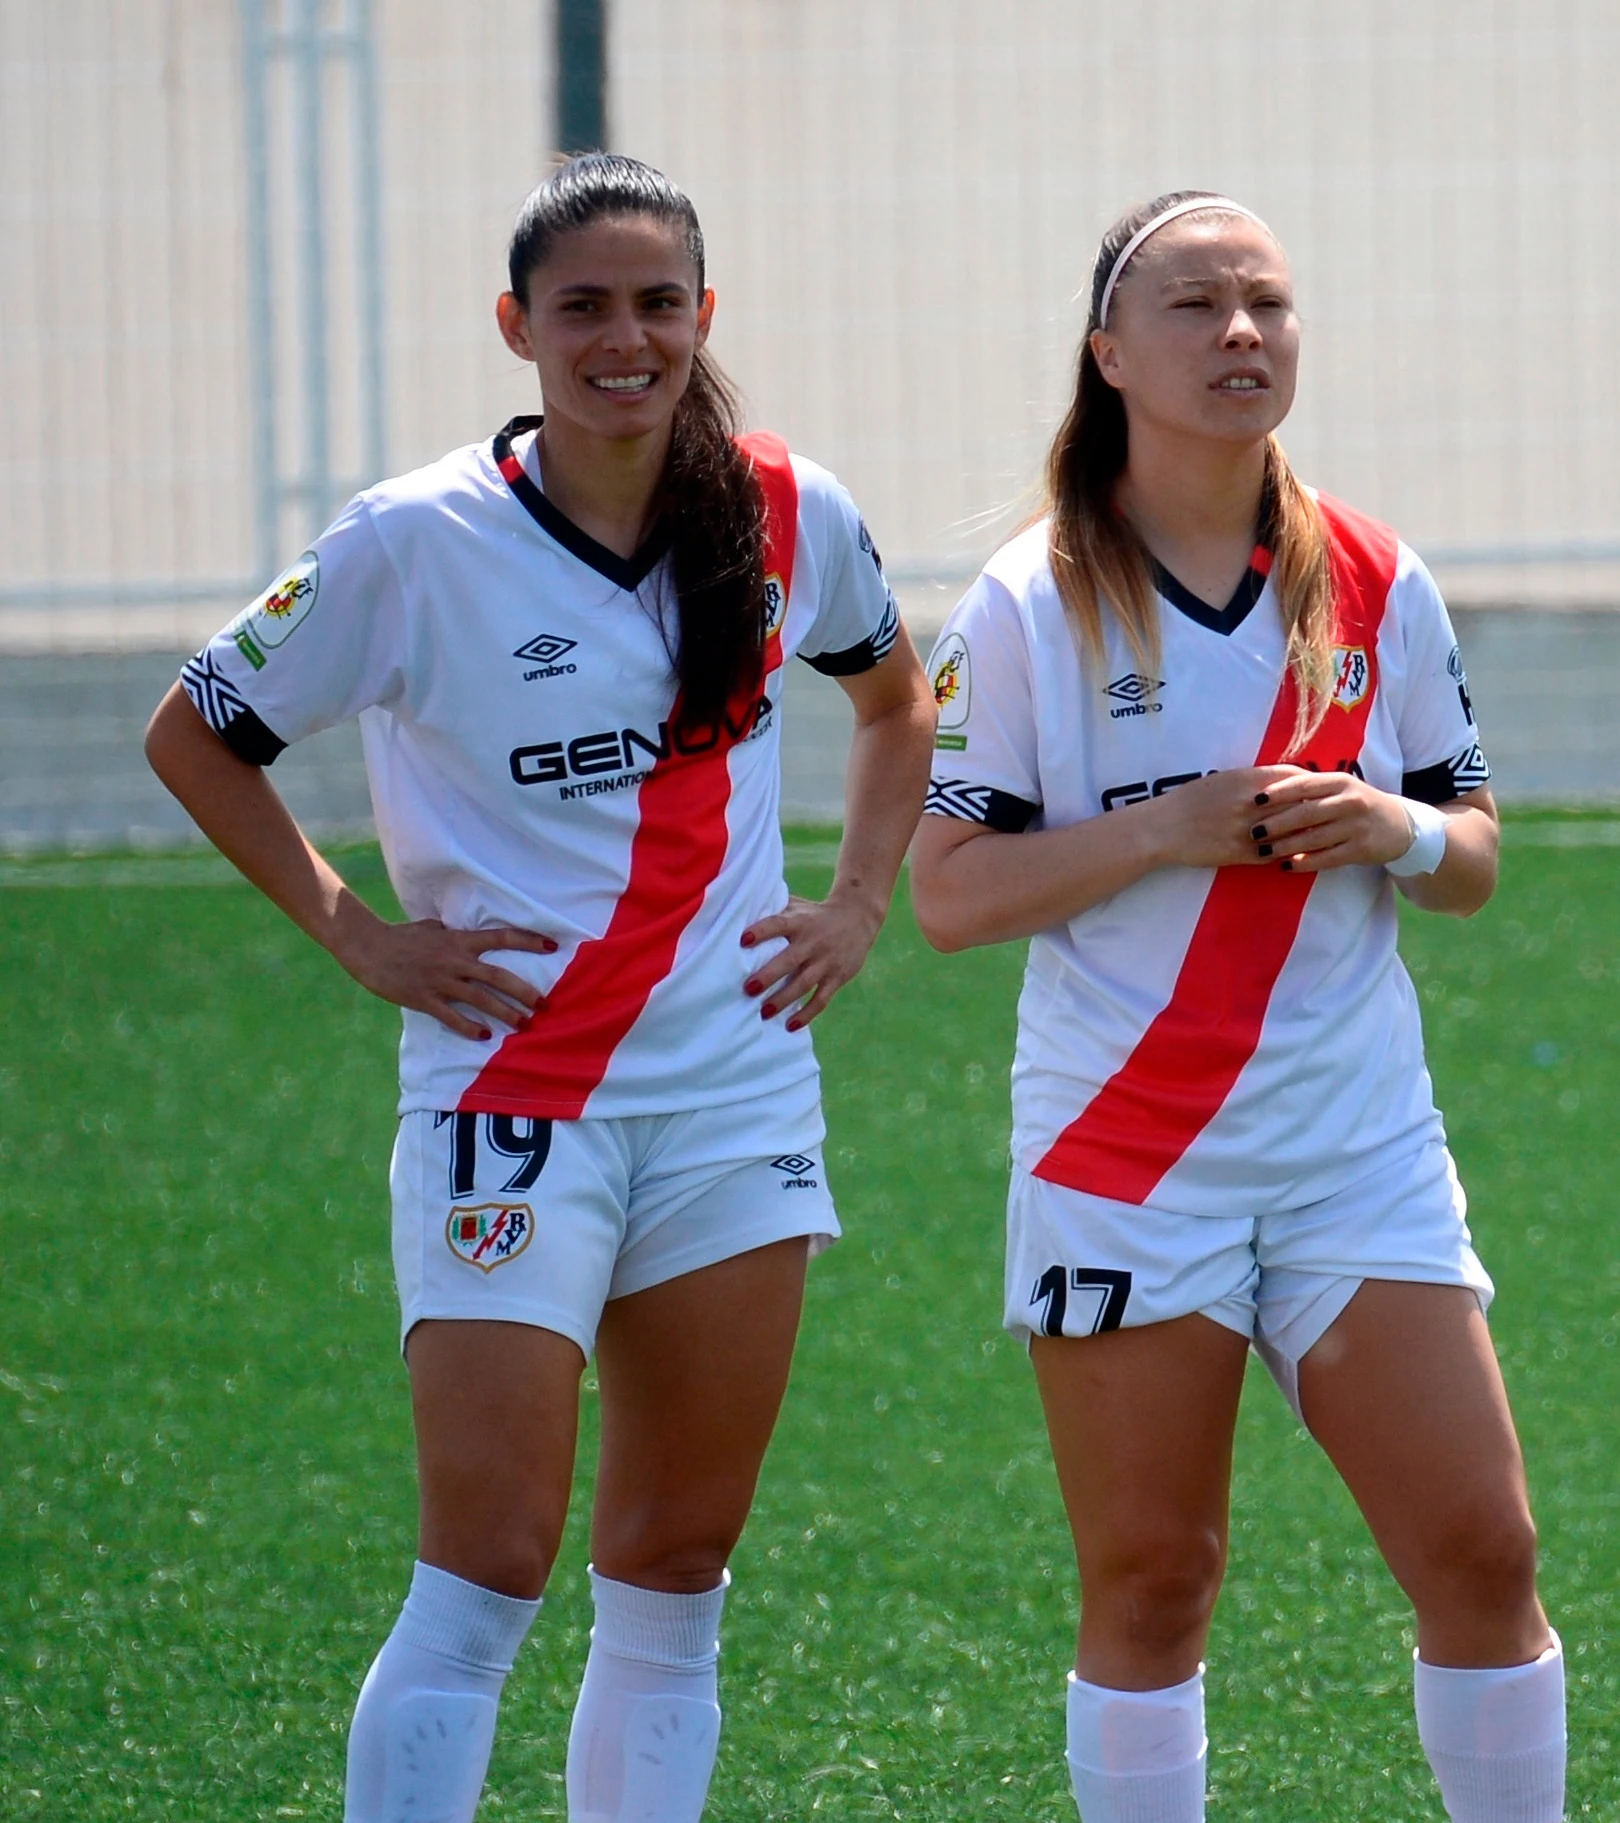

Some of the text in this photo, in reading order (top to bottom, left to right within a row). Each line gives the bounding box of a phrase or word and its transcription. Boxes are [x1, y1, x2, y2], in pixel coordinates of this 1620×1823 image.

[523, 663, 577, 682] umbro
[559, 771, 650, 801] INTERNATIO
[433, 1110, 553, 1200] 19
[781, 1177, 818, 1190] umbro
[1028, 1264, 1133, 1338] 17
